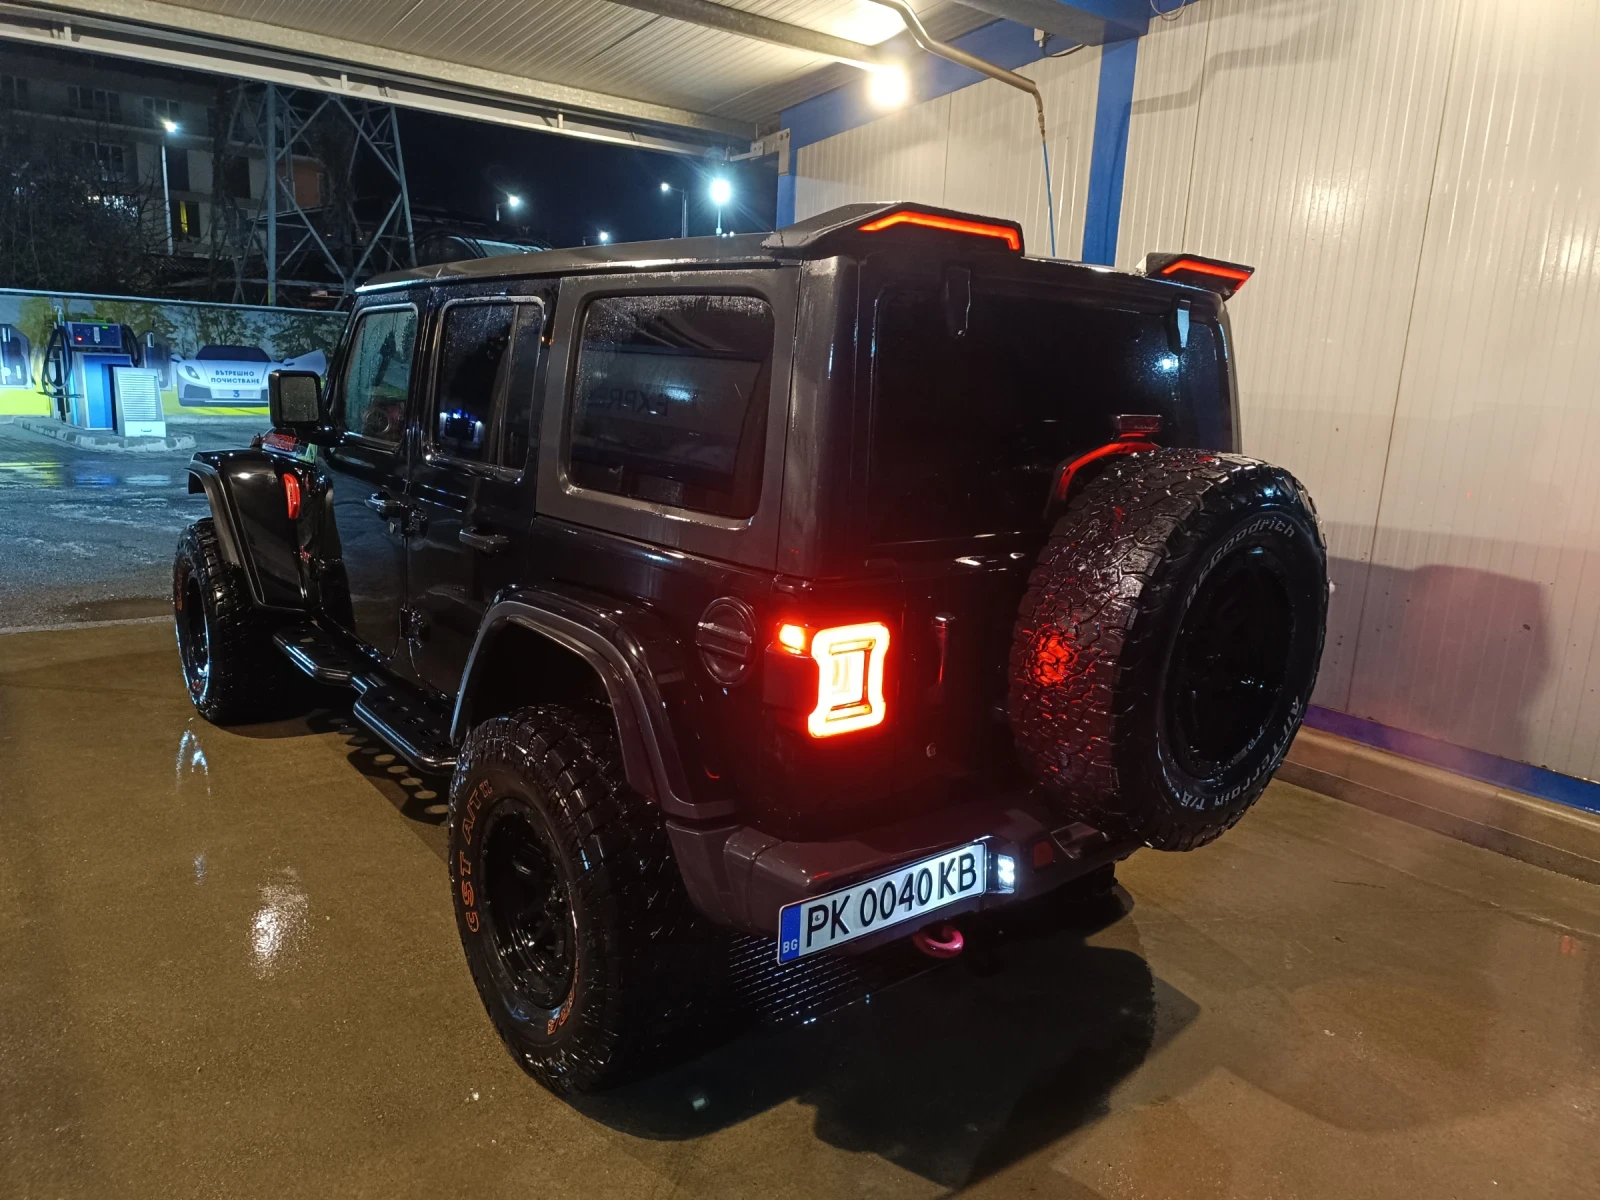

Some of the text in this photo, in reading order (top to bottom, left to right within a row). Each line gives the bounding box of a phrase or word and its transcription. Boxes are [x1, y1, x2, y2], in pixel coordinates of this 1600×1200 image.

[233, 390, 240, 398] 3
[806, 852, 978, 948] PK 0040 KB
[782, 938, 799, 954] BG
